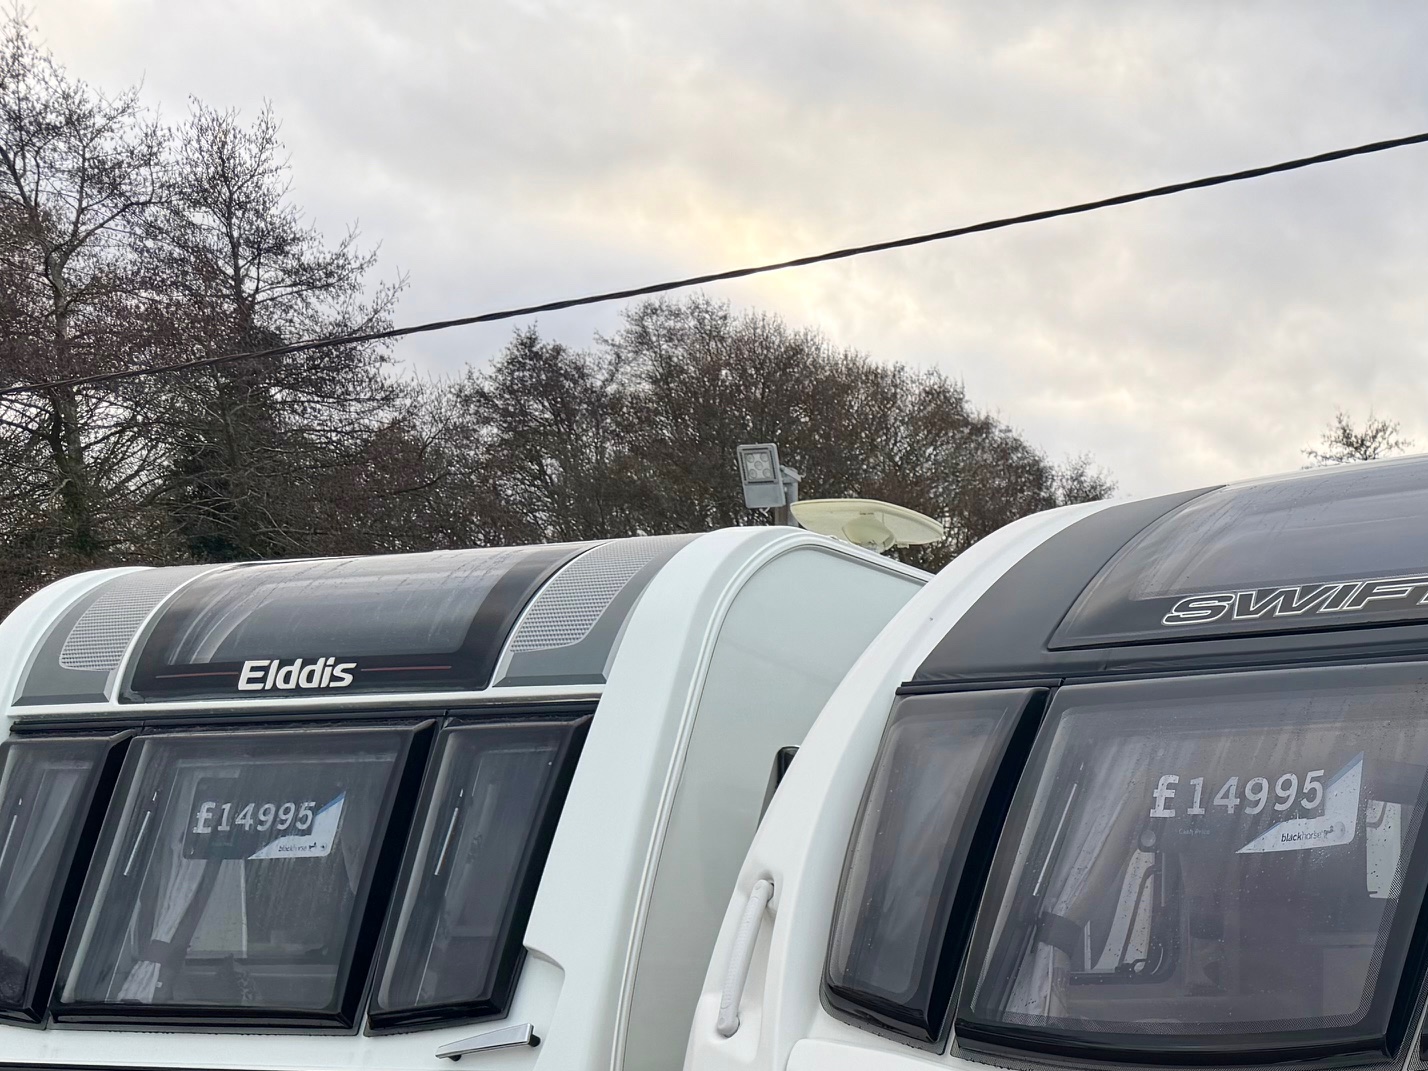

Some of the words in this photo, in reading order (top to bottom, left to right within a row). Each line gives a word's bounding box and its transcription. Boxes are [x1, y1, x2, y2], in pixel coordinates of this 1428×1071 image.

[237, 656, 358, 691] Elddis
[1150, 768, 1325, 818] £14995
[192, 801, 316, 834] £14995
